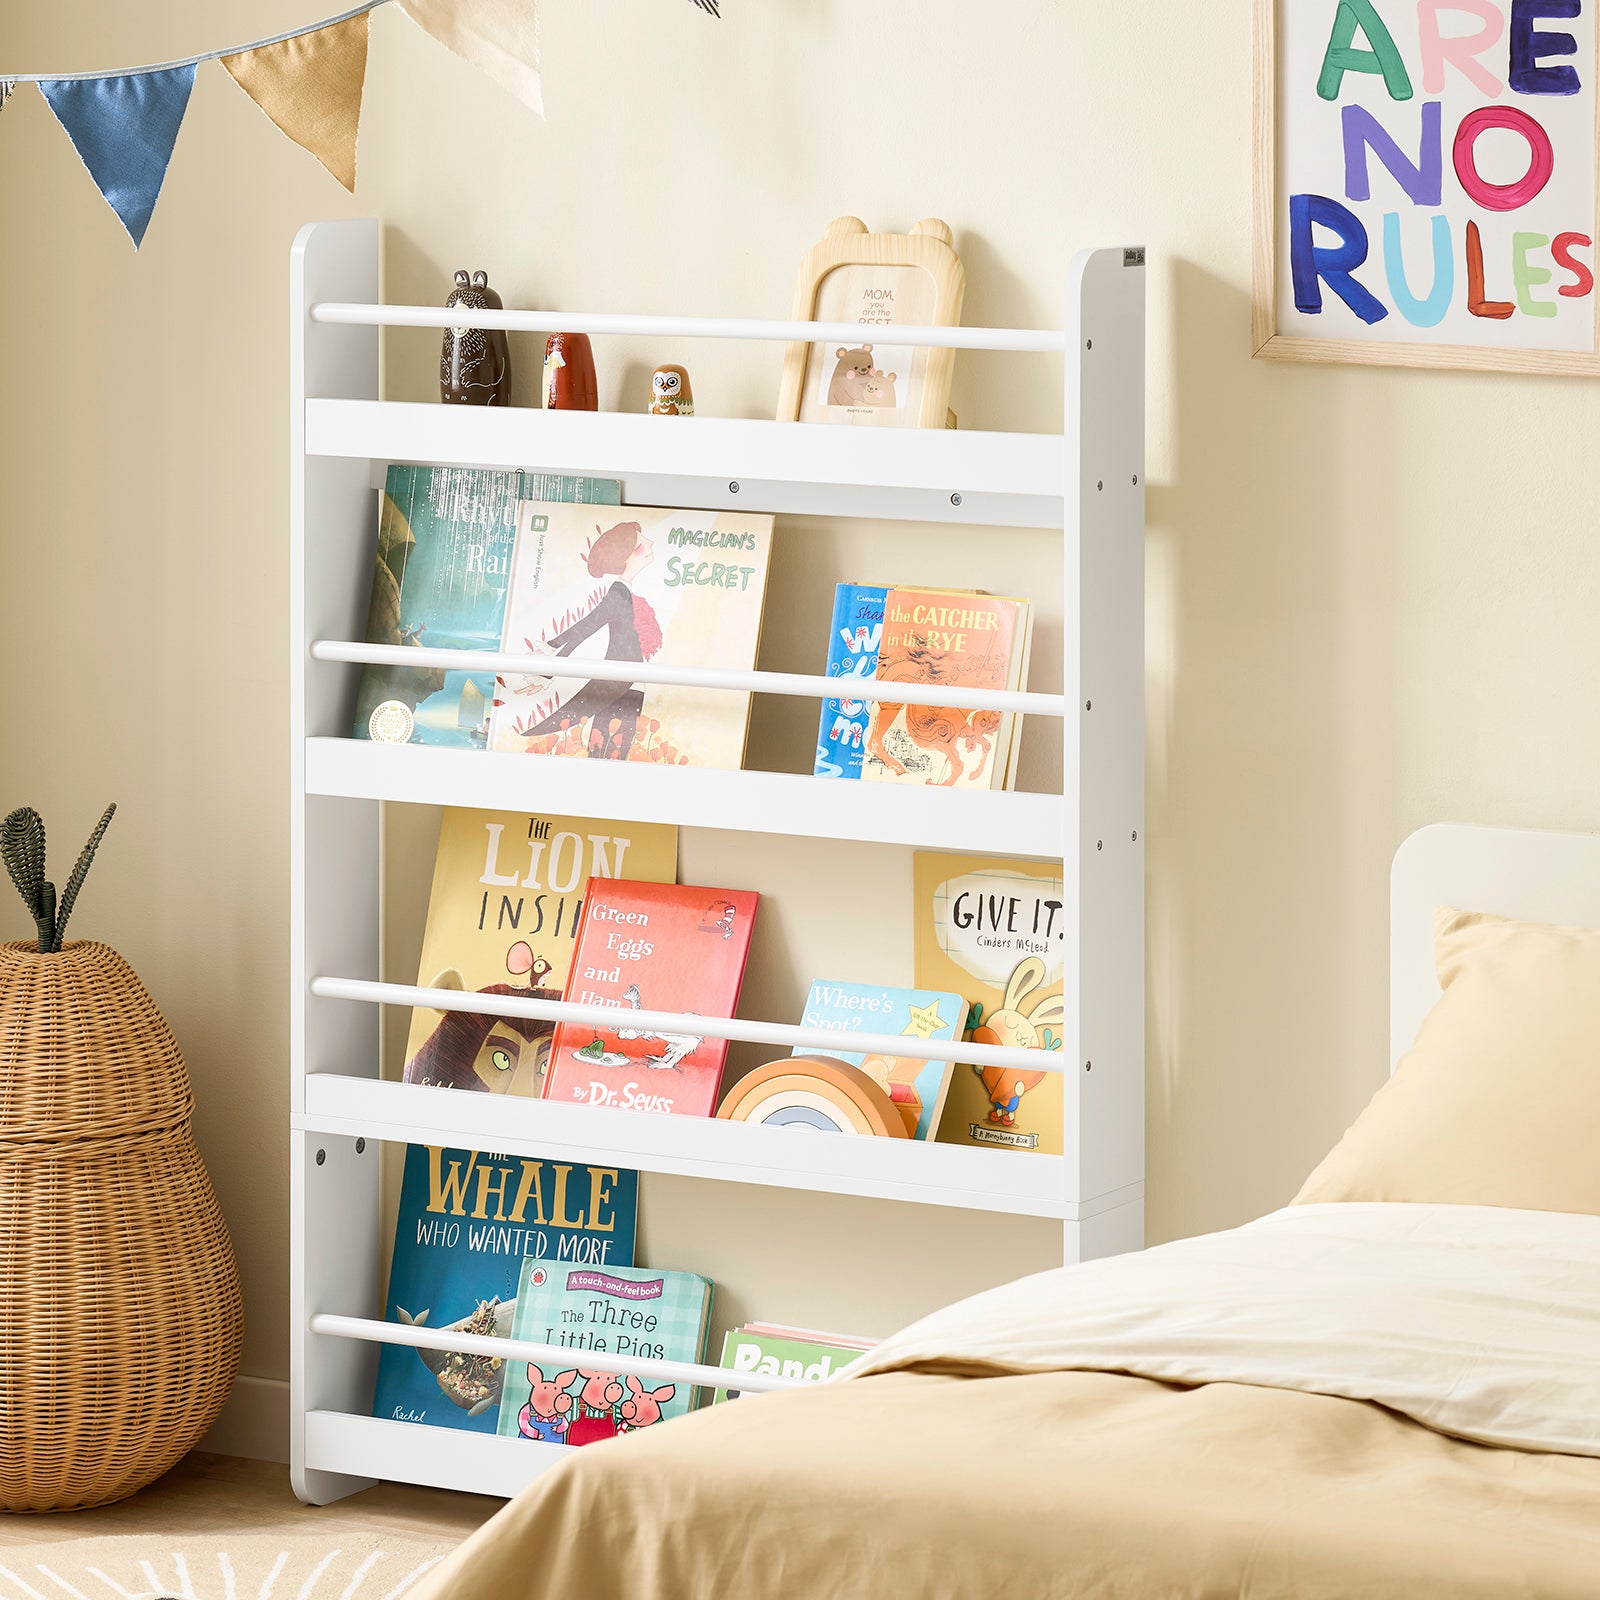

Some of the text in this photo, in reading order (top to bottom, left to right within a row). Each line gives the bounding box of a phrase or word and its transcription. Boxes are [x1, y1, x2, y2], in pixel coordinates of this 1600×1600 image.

[1316, 0, 1582, 101] ARE
[1341, 101, 1554, 212] NO
[1289, 193, 1594, 328] RULES
[500, 533, 514, 544] the
[667, 527, 755, 550] MAGICIAN'S
[466, 543, 513, 575] Rai
[663, 556, 756, 591] SECRET
[890, 604, 1000, 631] the CATCHER
[888, 632, 899, 646] in
[926, 630, 967, 652] RYE
[528, 817, 552, 839] THE
[479, 823, 631, 893] LION
[592, 903, 649, 927] Green
[953, 892, 1021, 932] GIVE
[605, 932, 655, 960] Eggs
[977, 935, 1011, 948] Cinders
[583, 966, 621, 983] and
[580, 990, 621, 1008] Ham
[814, 985, 894, 1013] Where's
[573, 1081, 674, 1113] By Dr. Seuss
[423, 1144, 619, 1232] WHALE
[416, 1218, 614, 1265] WHO WANTED MORE
[571, 1276, 661, 1296] A touch-and-feel book
[561, 1300, 658, 1332] The Three
[733, 1343, 844, 1381] Pand
[391, 1405, 426, 1423] Rachel
